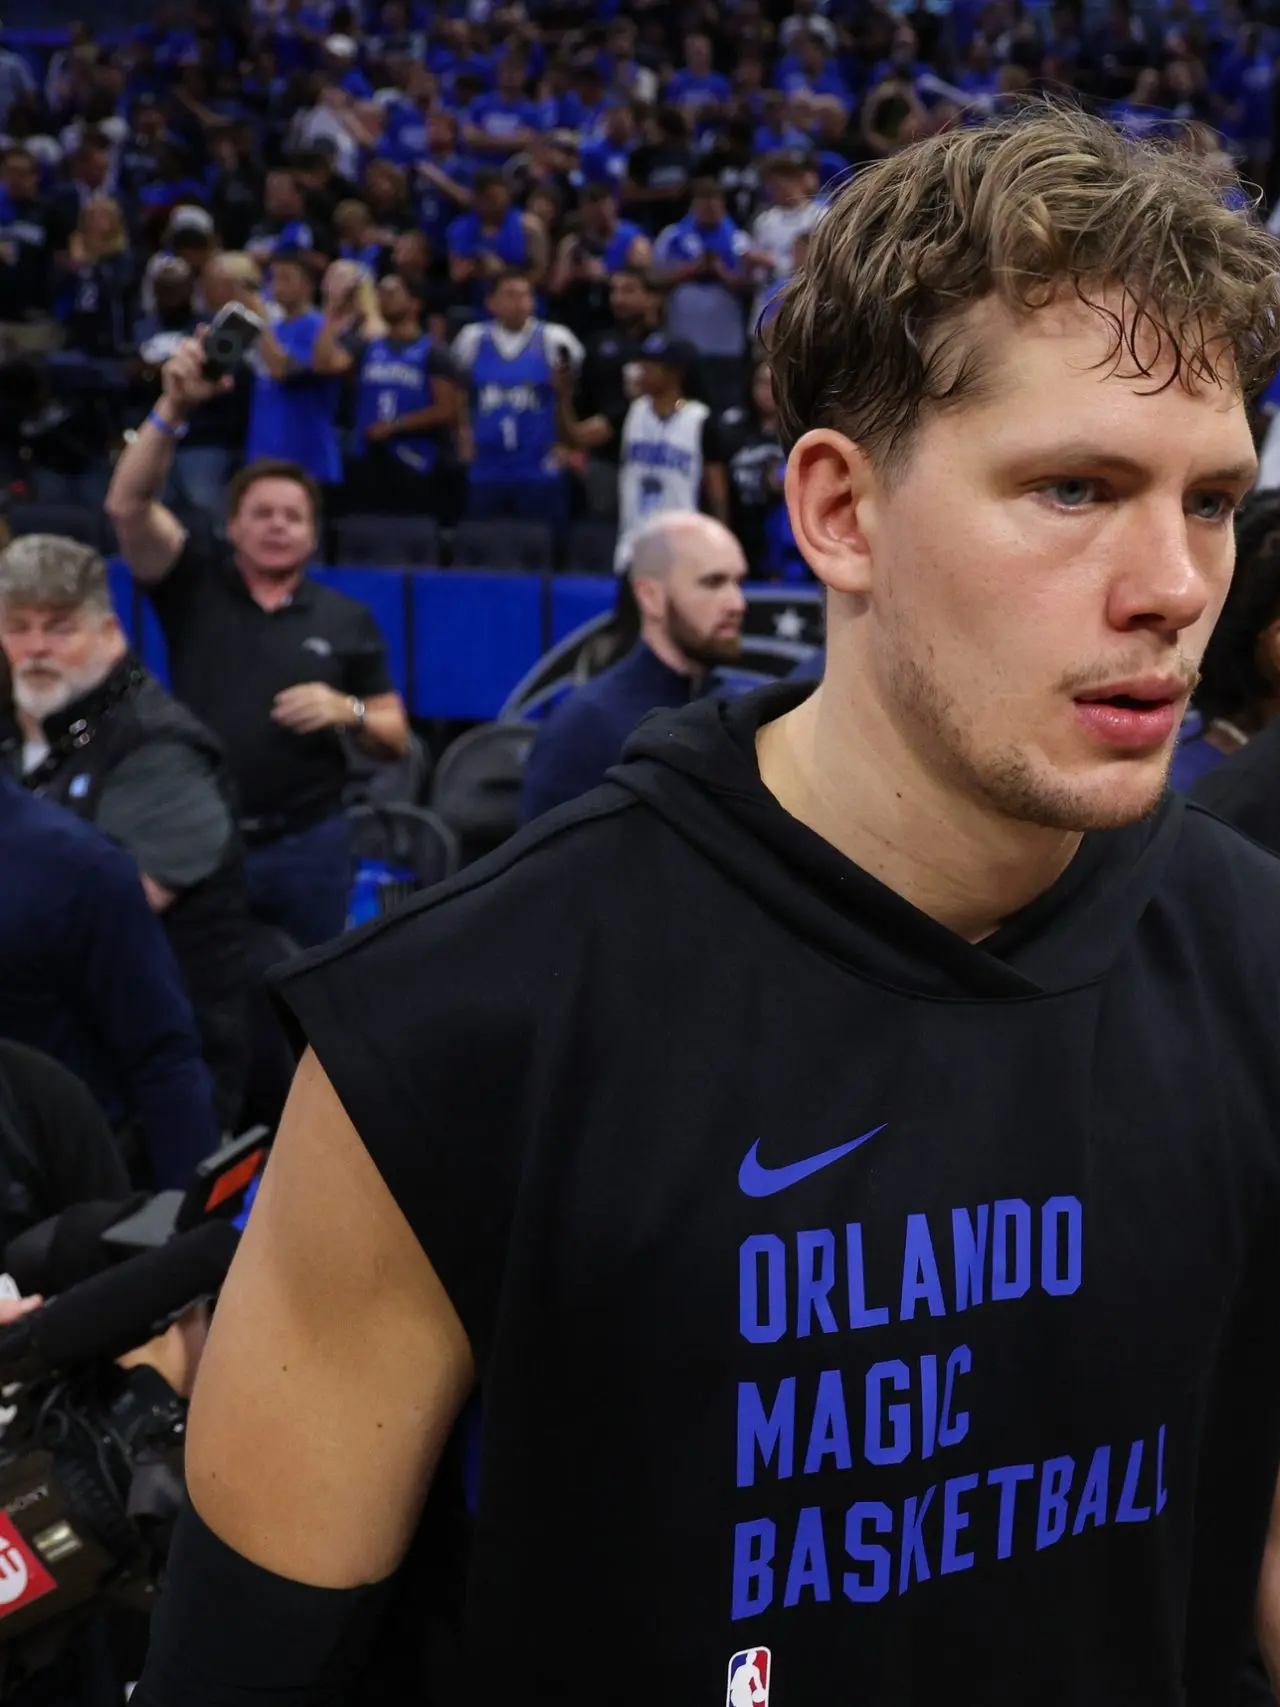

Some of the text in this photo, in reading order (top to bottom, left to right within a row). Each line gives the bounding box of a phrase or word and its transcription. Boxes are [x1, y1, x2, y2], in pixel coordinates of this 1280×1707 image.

[738, 1194, 1083, 1344] ORLANDO
[736, 1344, 972, 1487] MAGIC
[731, 1424, 1168, 1620] BASKETBALL
